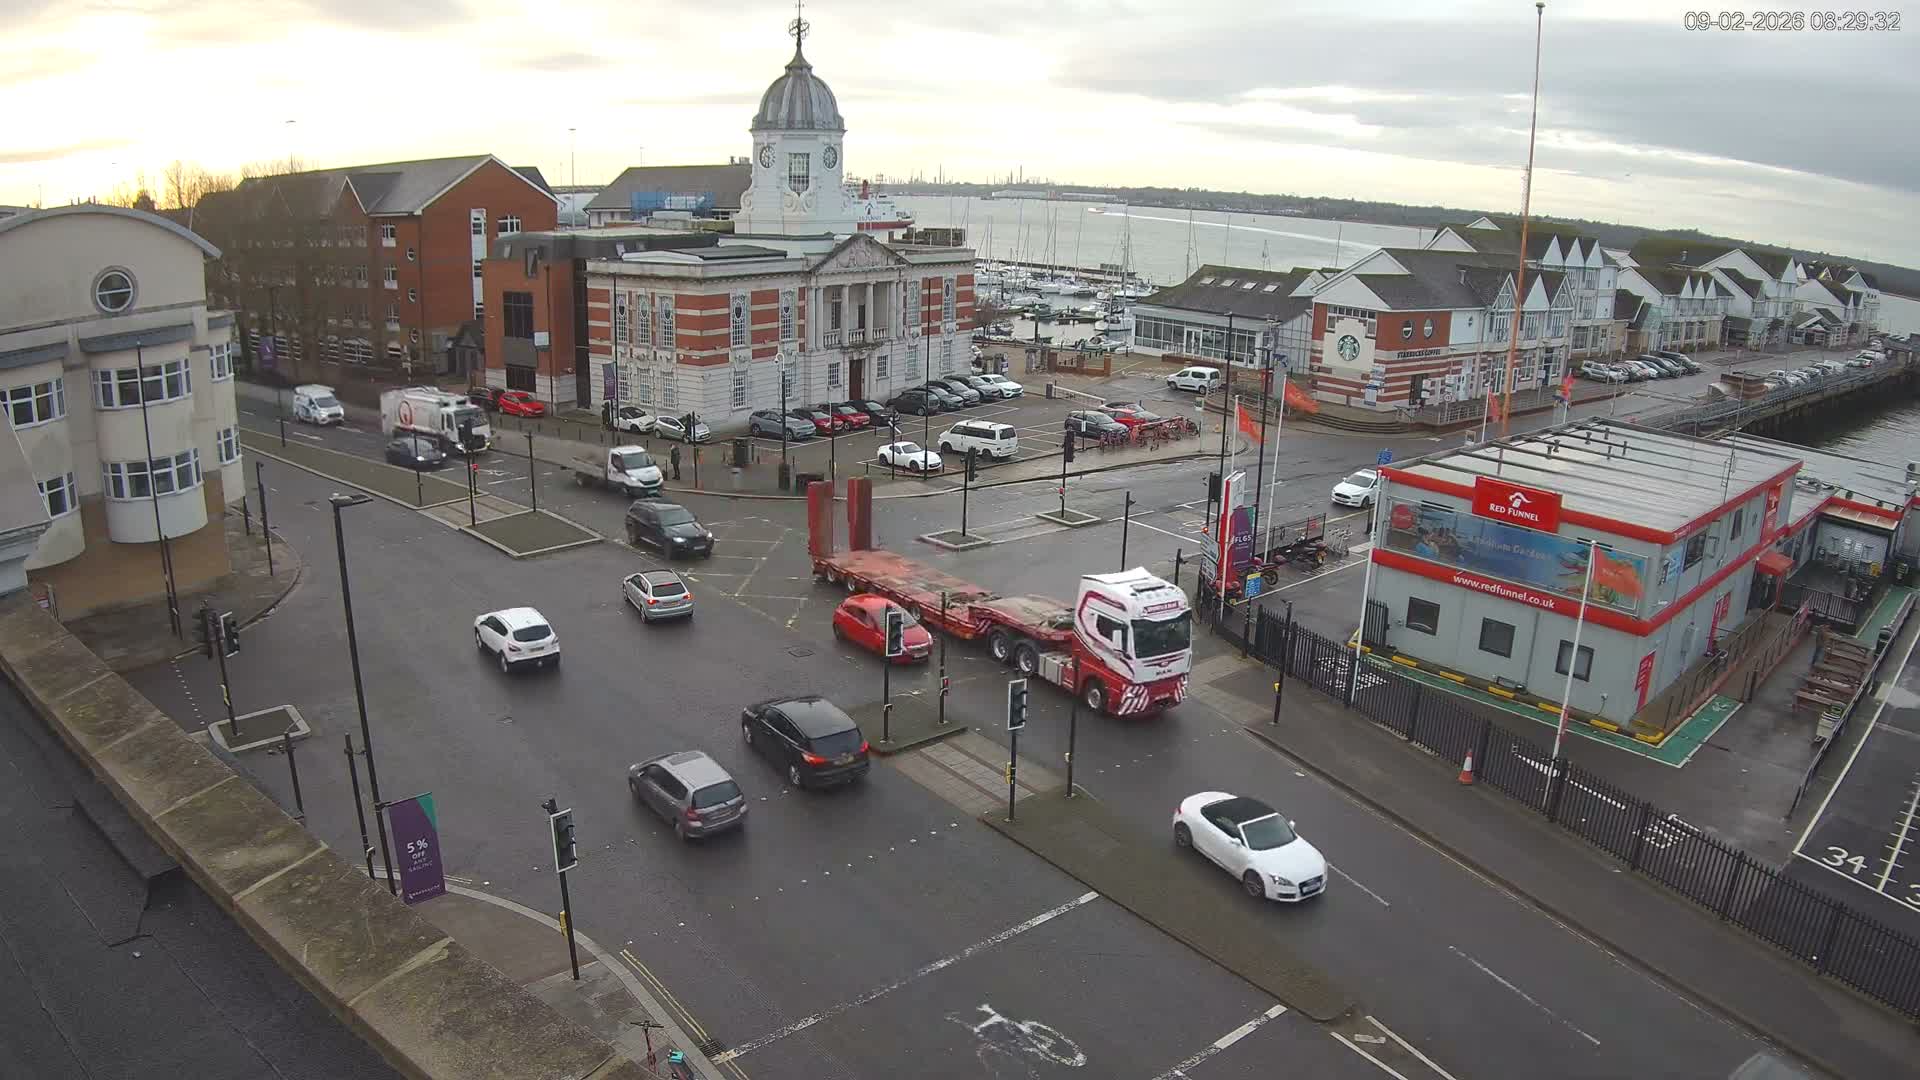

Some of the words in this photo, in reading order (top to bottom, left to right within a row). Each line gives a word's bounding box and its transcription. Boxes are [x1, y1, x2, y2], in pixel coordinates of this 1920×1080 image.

[1489, 503, 1506, 514] RED
[1507, 507, 1540, 522] FUNNEL
[1453, 575, 1555, 608] www.redfunnel.co.uk
[1821, 846, 1868, 875] 34
